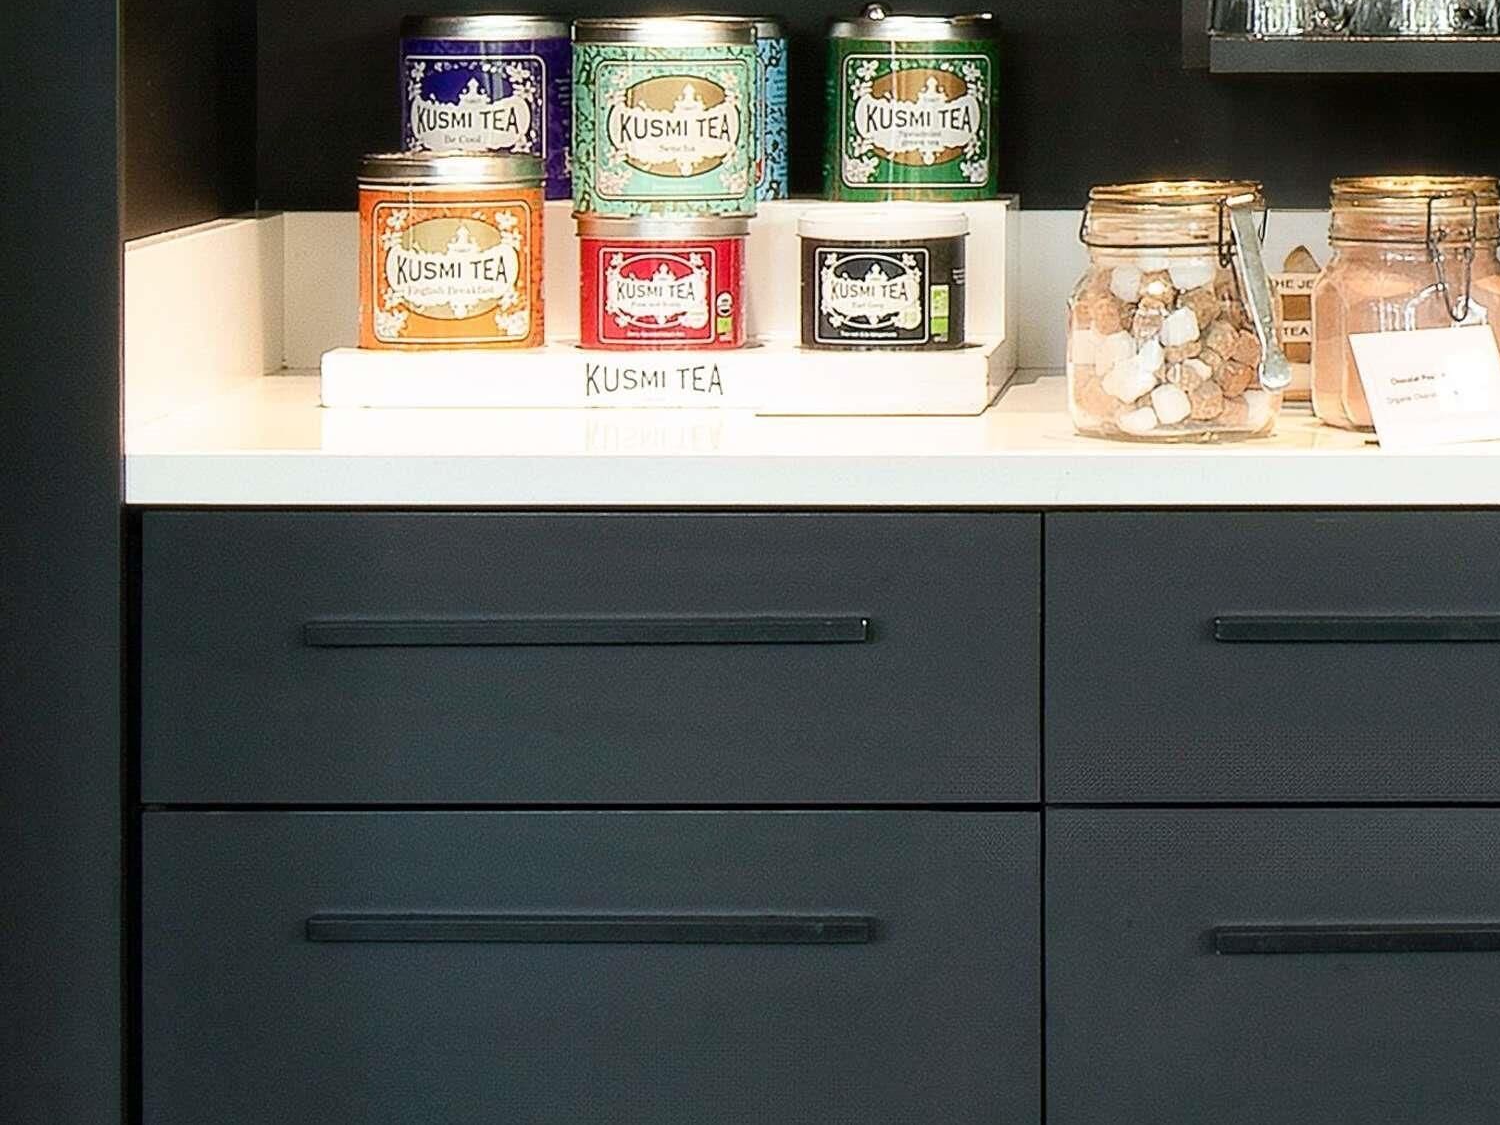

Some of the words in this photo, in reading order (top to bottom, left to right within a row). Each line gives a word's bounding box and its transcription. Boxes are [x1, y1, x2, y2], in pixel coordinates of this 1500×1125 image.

[416, 105, 472, 134] KUSMI
[479, 106, 519, 134] TEA
[620, 113, 688, 143] KUSMI
[696, 113, 731, 142] TEA
[866, 104, 932, 132] KUSMI
[938, 105, 972, 133] TEA
[396, 255, 462, 285] KUSMI
[470, 255, 508, 284] TEA
[616, 281, 663, 300] KUSMI
[668, 281, 695, 300] TEA
[830, 281, 875, 301] KUSMI
[881, 281, 908, 301] TEA
[1283, 327, 1309, 336] TEA
[586, 362, 666, 396] KUSMI
[676, 363, 724, 396] TEA
